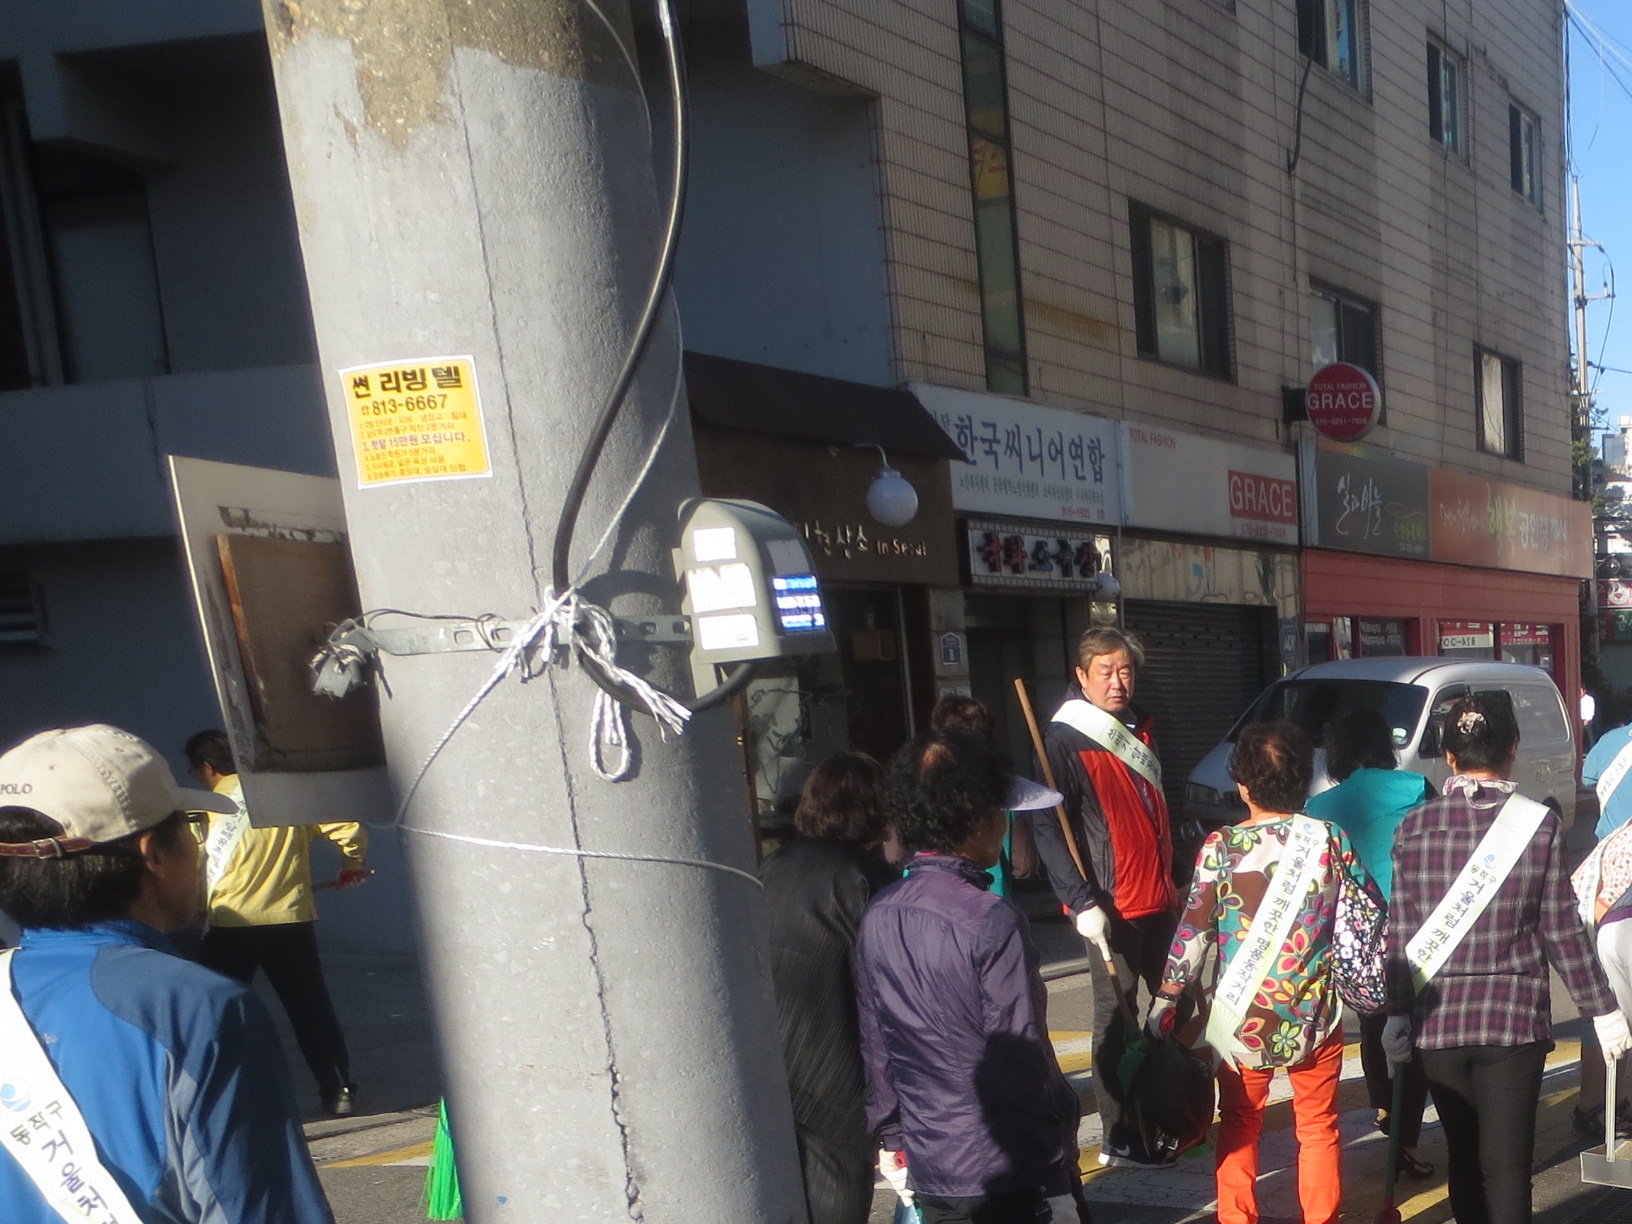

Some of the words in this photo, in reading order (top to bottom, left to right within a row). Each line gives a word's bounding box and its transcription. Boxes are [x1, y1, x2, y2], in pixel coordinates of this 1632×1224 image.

[372, 394, 448, 417] 813-6667
[1307, 392, 1374, 410] GRACE
[1313, 383, 1335, 392] TOTAL
[389, 434, 419, 448] 15만원
[954, 414, 1105, 484] 한국씨니어연합
[1129, 426, 1149, 443] TOTAL
[1150, 432, 1176, 449] FASHION
[1229, 474, 1293, 518] GRACE
[1281, 844, 1312, 895] 거울처럼
[1262, 896, 1290, 937] 깨끗한
[1444, 878, 1485, 930] 거울처럼
[1417, 927, 1451, 963] 깨끗한
[9, 1099, 64, 1146] 동작구
